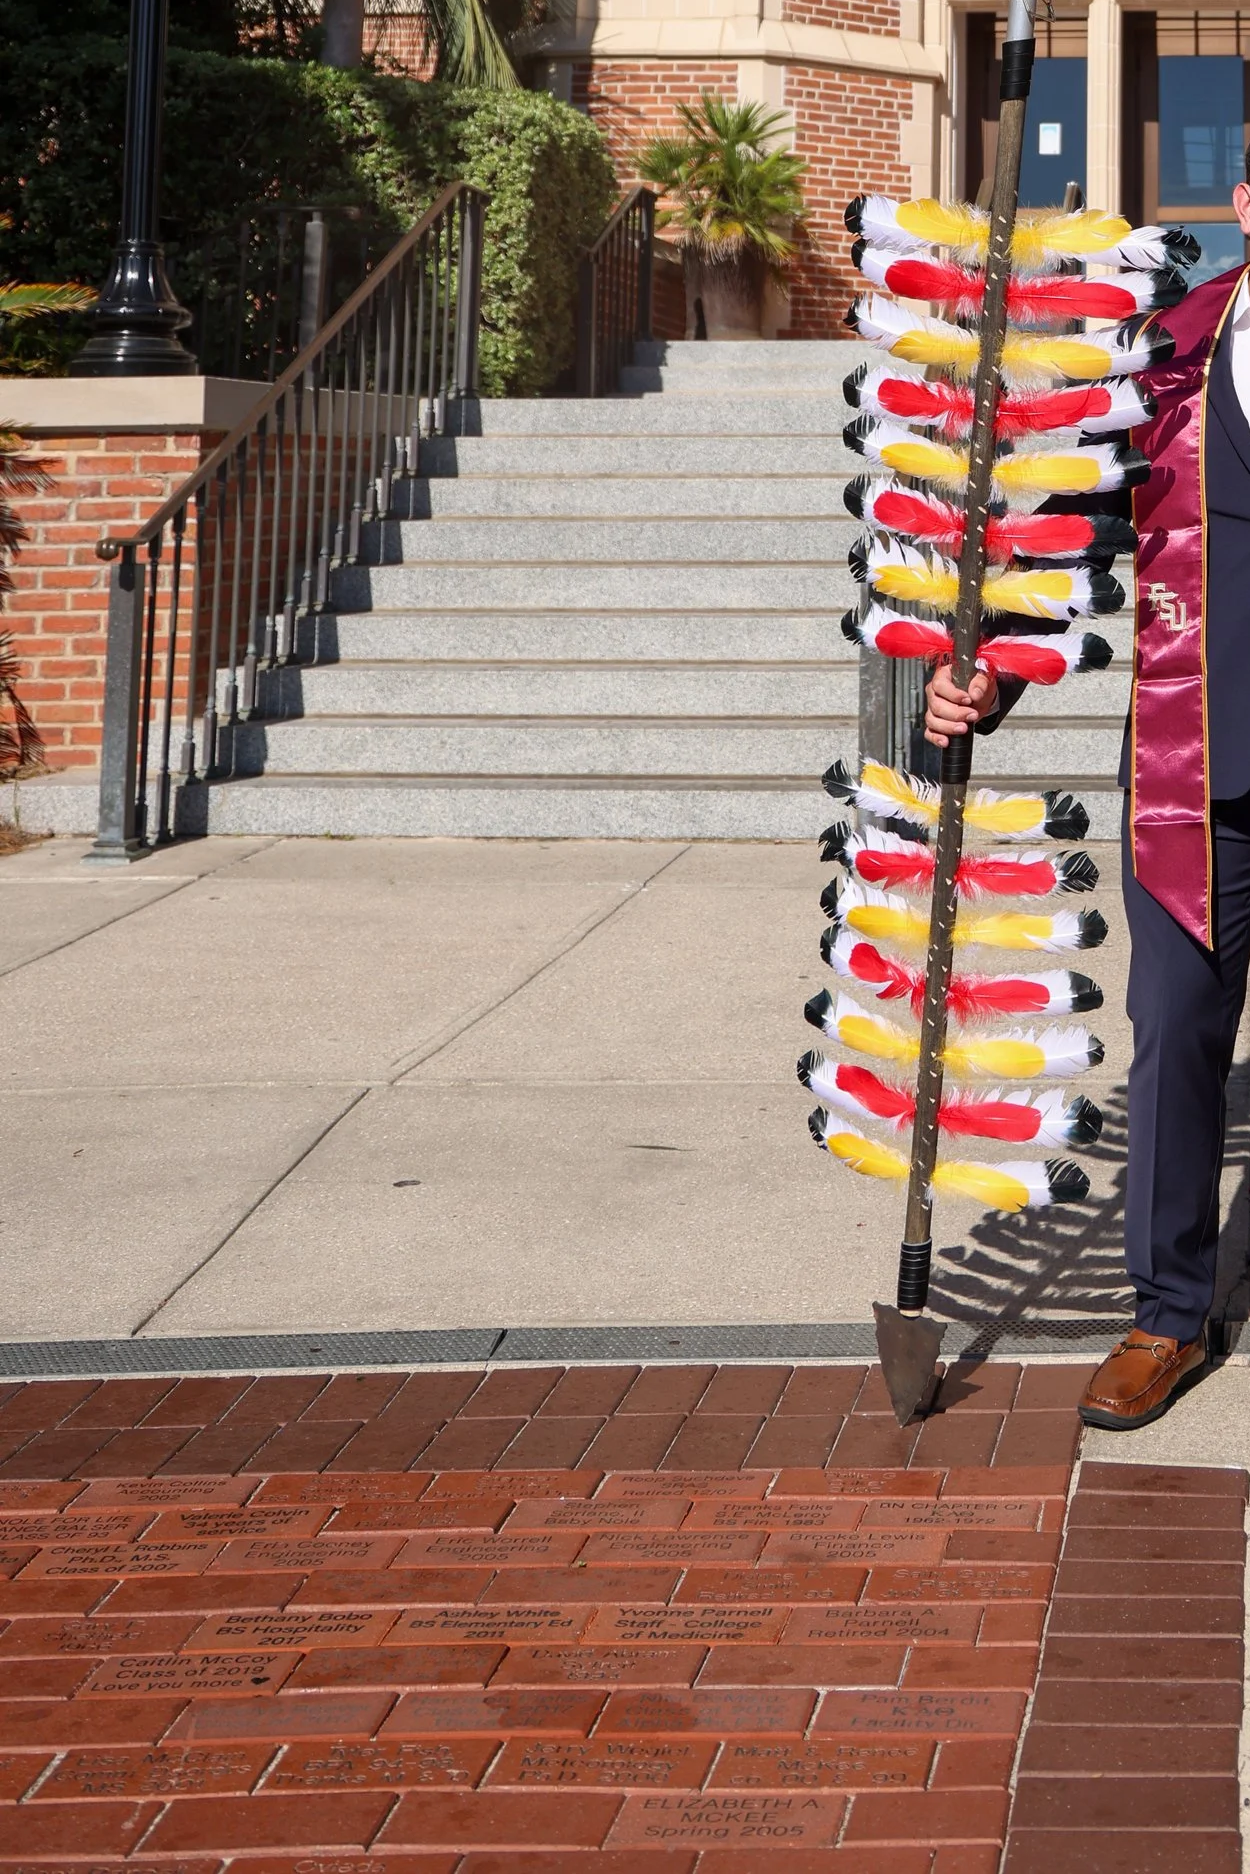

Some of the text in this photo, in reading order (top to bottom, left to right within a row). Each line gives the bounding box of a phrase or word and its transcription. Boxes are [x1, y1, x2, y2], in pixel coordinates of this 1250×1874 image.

[1147, 582, 1187, 630] FSU
[168, 1479, 227, 1487] Collins
[119, 1487, 215, 1495] Accounting
[912, 1502, 1000, 1510] CHAPTER
[50, 1515, 136, 1524] FOR LIFE
[180, 1508, 311, 1522] Valerie Colvin
[214, 1519, 266, 1528] years
[55, 1531, 81, 1540] OF
[196, 1526, 267, 1536] service
[600, 1533, 644, 1541] Nick
[50, 1541, 209, 1556] Cheryl Robbins
[425, 1544, 551, 1555] Engineering
[609, 1541, 733, 1550] Engineering
[813, 1542, 895, 1550] Finance
[130, 1553, 170, 1562] M.S.
[244, 1548, 368, 1559] Engineering
[457, 1553, 510, 1561] 2005
[641, 1550, 693, 1558] 2005
[826, 1550, 877, 1558] 2005
[272, 1558, 324, 1566] 2005
[45, 1563, 180, 1575] Class of 2007
[435, 1609, 562, 1619] Ashley White
[619, 1608, 774, 1618] Yvonne Parnell
[825, 1609, 914, 1618] Barbara
[224, 1612, 374, 1625] Bethany Bobo
[843, 1618, 920, 1627] Parnell
[215, 1623, 366, 1635] BS Hospitality
[440, 1619, 544, 1630] Elementary
[547, 1619, 574, 1627] Ed
[614, 1619, 762, 1630] Staff College
[463, 1630, 505, 1638] 2011
[621, 1630, 745, 1640] of Medicine
[808, 1628, 950, 1638] Retired 2004
[258, 1636, 307, 1646] 2017
[119, 1654, 279, 1668] Caitlin McCoy
[115, 1666, 265, 1679] Class of 2019
[90, 1679, 243, 1692] Love you more
[777, 1760, 867, 1771] McKee
[642, 1797, 825, 1810] ELIZABETH A.
[680, 1812, 779, 1824] MCKEE
[644, 1826, 805, 1838] Spring 2005
